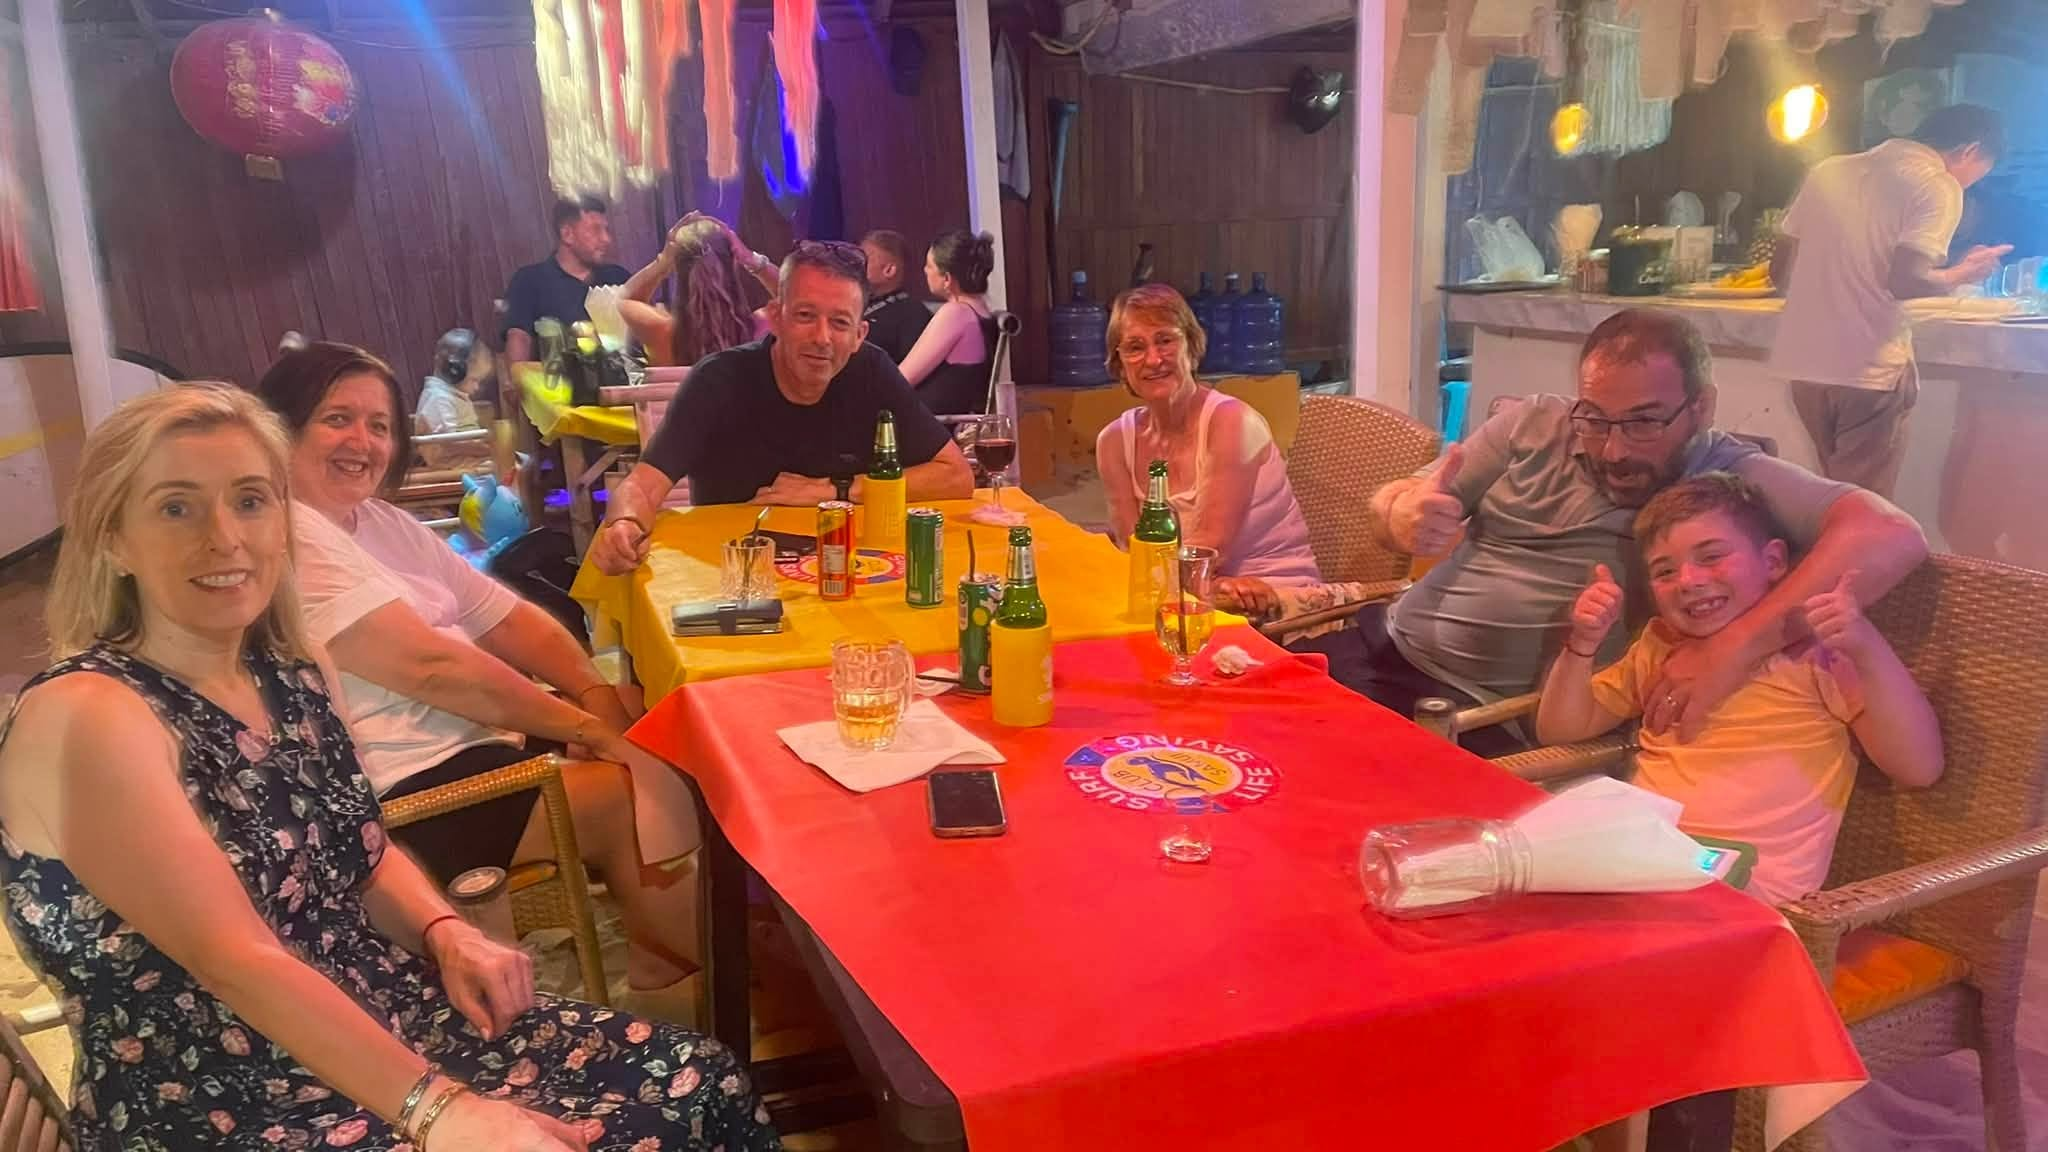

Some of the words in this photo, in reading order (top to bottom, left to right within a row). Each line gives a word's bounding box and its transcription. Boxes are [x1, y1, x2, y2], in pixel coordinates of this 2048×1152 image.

[1114, 735, 1256, 763] SAVING
[1169, 751, 1227, 776] SAMUI
[1069, 771, 1152, 810] SURF
[1111, 769, 1164, 792] CLUB
[1234, 767, 1273, 801] LIFE
